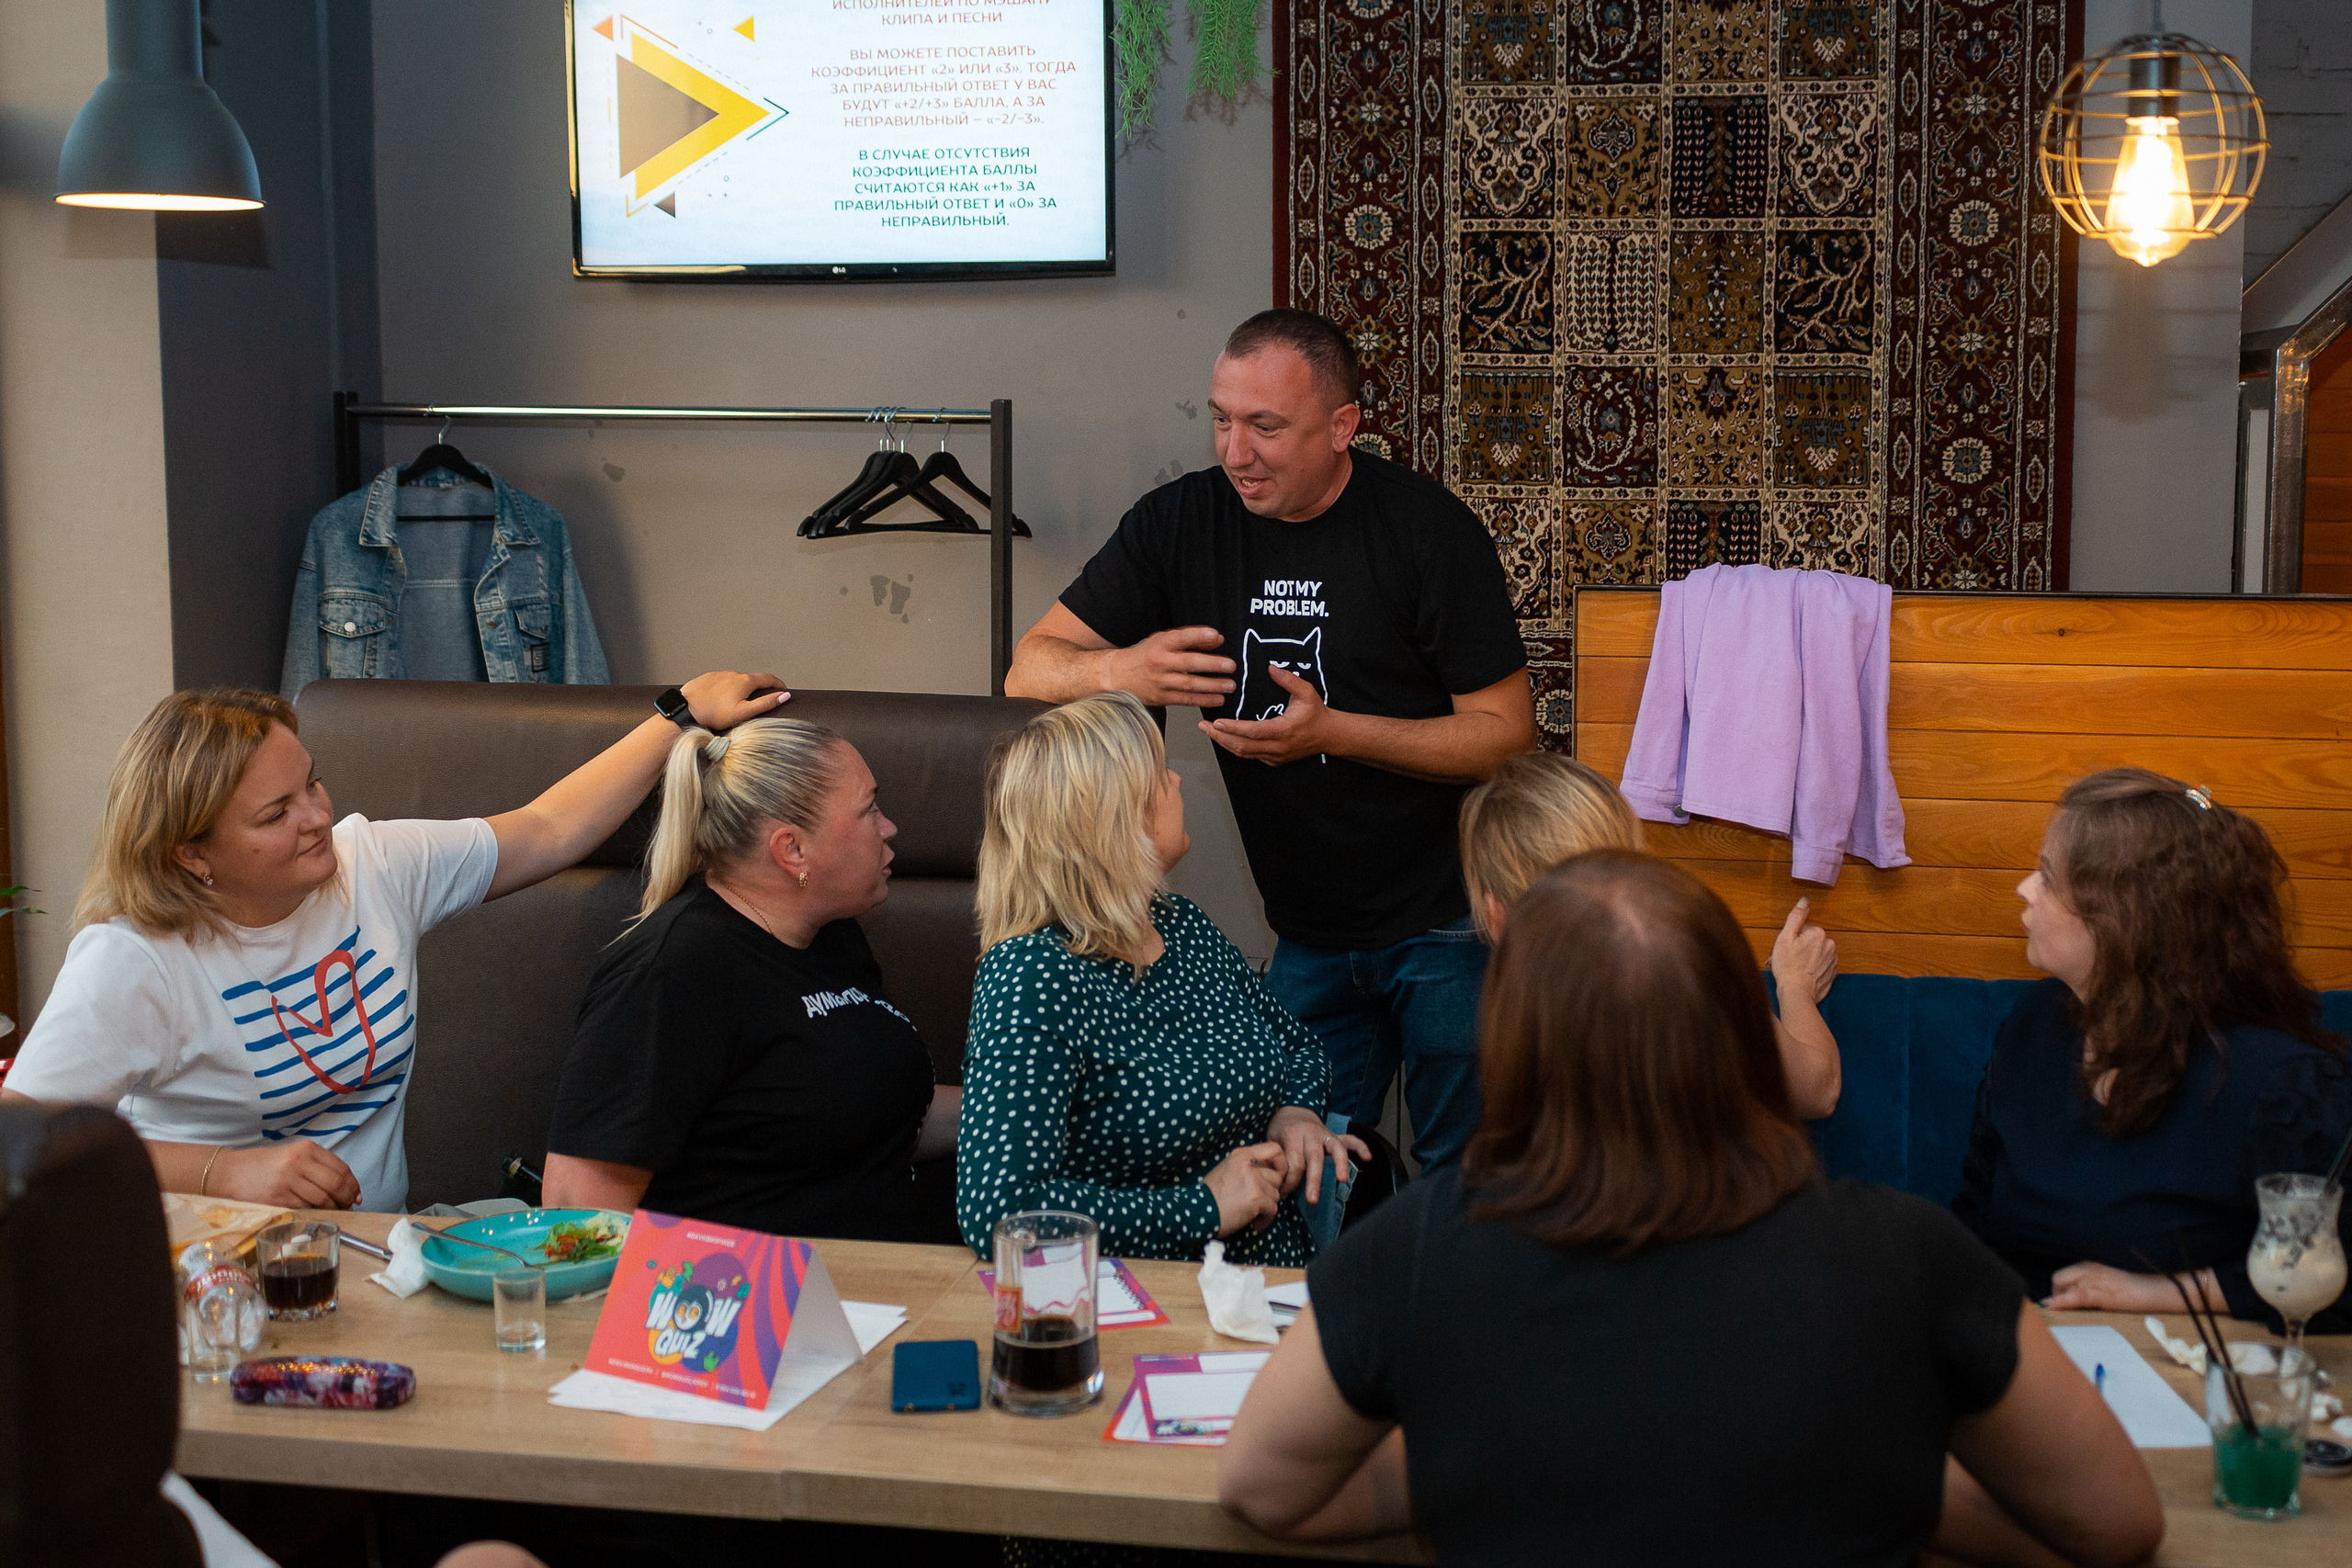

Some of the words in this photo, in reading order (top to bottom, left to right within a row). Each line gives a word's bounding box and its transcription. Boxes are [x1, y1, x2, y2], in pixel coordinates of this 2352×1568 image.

[882, 15, 933, 25] КЛИПА
[938, 15, 947, 23] И
[953, 12, 1001, 22] ПЕСНИ
[850, 50, 871, 60] ВЫ
[877, 48, 942, 59] МОЖЕТЕ
[948, 46, 1035, 57] ПОСТАВИТЬ
[811, 65, 924, 78] КОЭФФИЦИЕНТ
[932, 64, 955, 74] «2»
[960, 63, 989, 73] ИЛИ
[1027, 62, 1077, 73] ТОГДА
[831, 84, 848, 94] ЗА
[854, 79, 957, 94] ПРАВИЛЬНЫЙ
[963, 80, 1008, 91] ОТВЕТ
[1013, 80, 1023, 90] У
[1028, 79, 1056, 89] ВАС
[842, 99, 889, 111] БУДУТ
[1013, 96, 1022, 107] А
[1028, 96, 1045, 106] ЗА
[845, 112, 968, 127] НЕПРАВИЛЬНЫЙ
[859, 150, 867, 160] В
[873, 149, 929, 160] СЛУЧАЕ
[934, 147, 1029, 159] ОТСУТСТВИЯ
[853, 165, 978, 177] КОЭФФИЦИЕНТА
[983, 164, 1036, 175] БАЛЛЫ
[854, 182, 944, 194] СЧИТАЮТСЯ
[950, 182, 978, 192] КАК
[984, 182, 1012, 191] «+1»
[1018, 181, 1035, 191] ЗА
[835, 197, 938, 210] ПРАВИЛЬНЫЙ
[944, 198, 989, 209] ОТВЕТ
[995, 198, 1004, 209] И
[1039, 197, 1057, 208] ЗА
[882, 213, 1009, 227] НЕПРАВИЛЬНЫЙ.
[1263, 580, 1294, 597] NOT
[1295, 581, 1322, 597] MY
[1250, 598, 1329, 617] PROBLEM.
[645, 1289, 741, 1337] WOW
[654, 1328, 707, 1359] QUIZ
